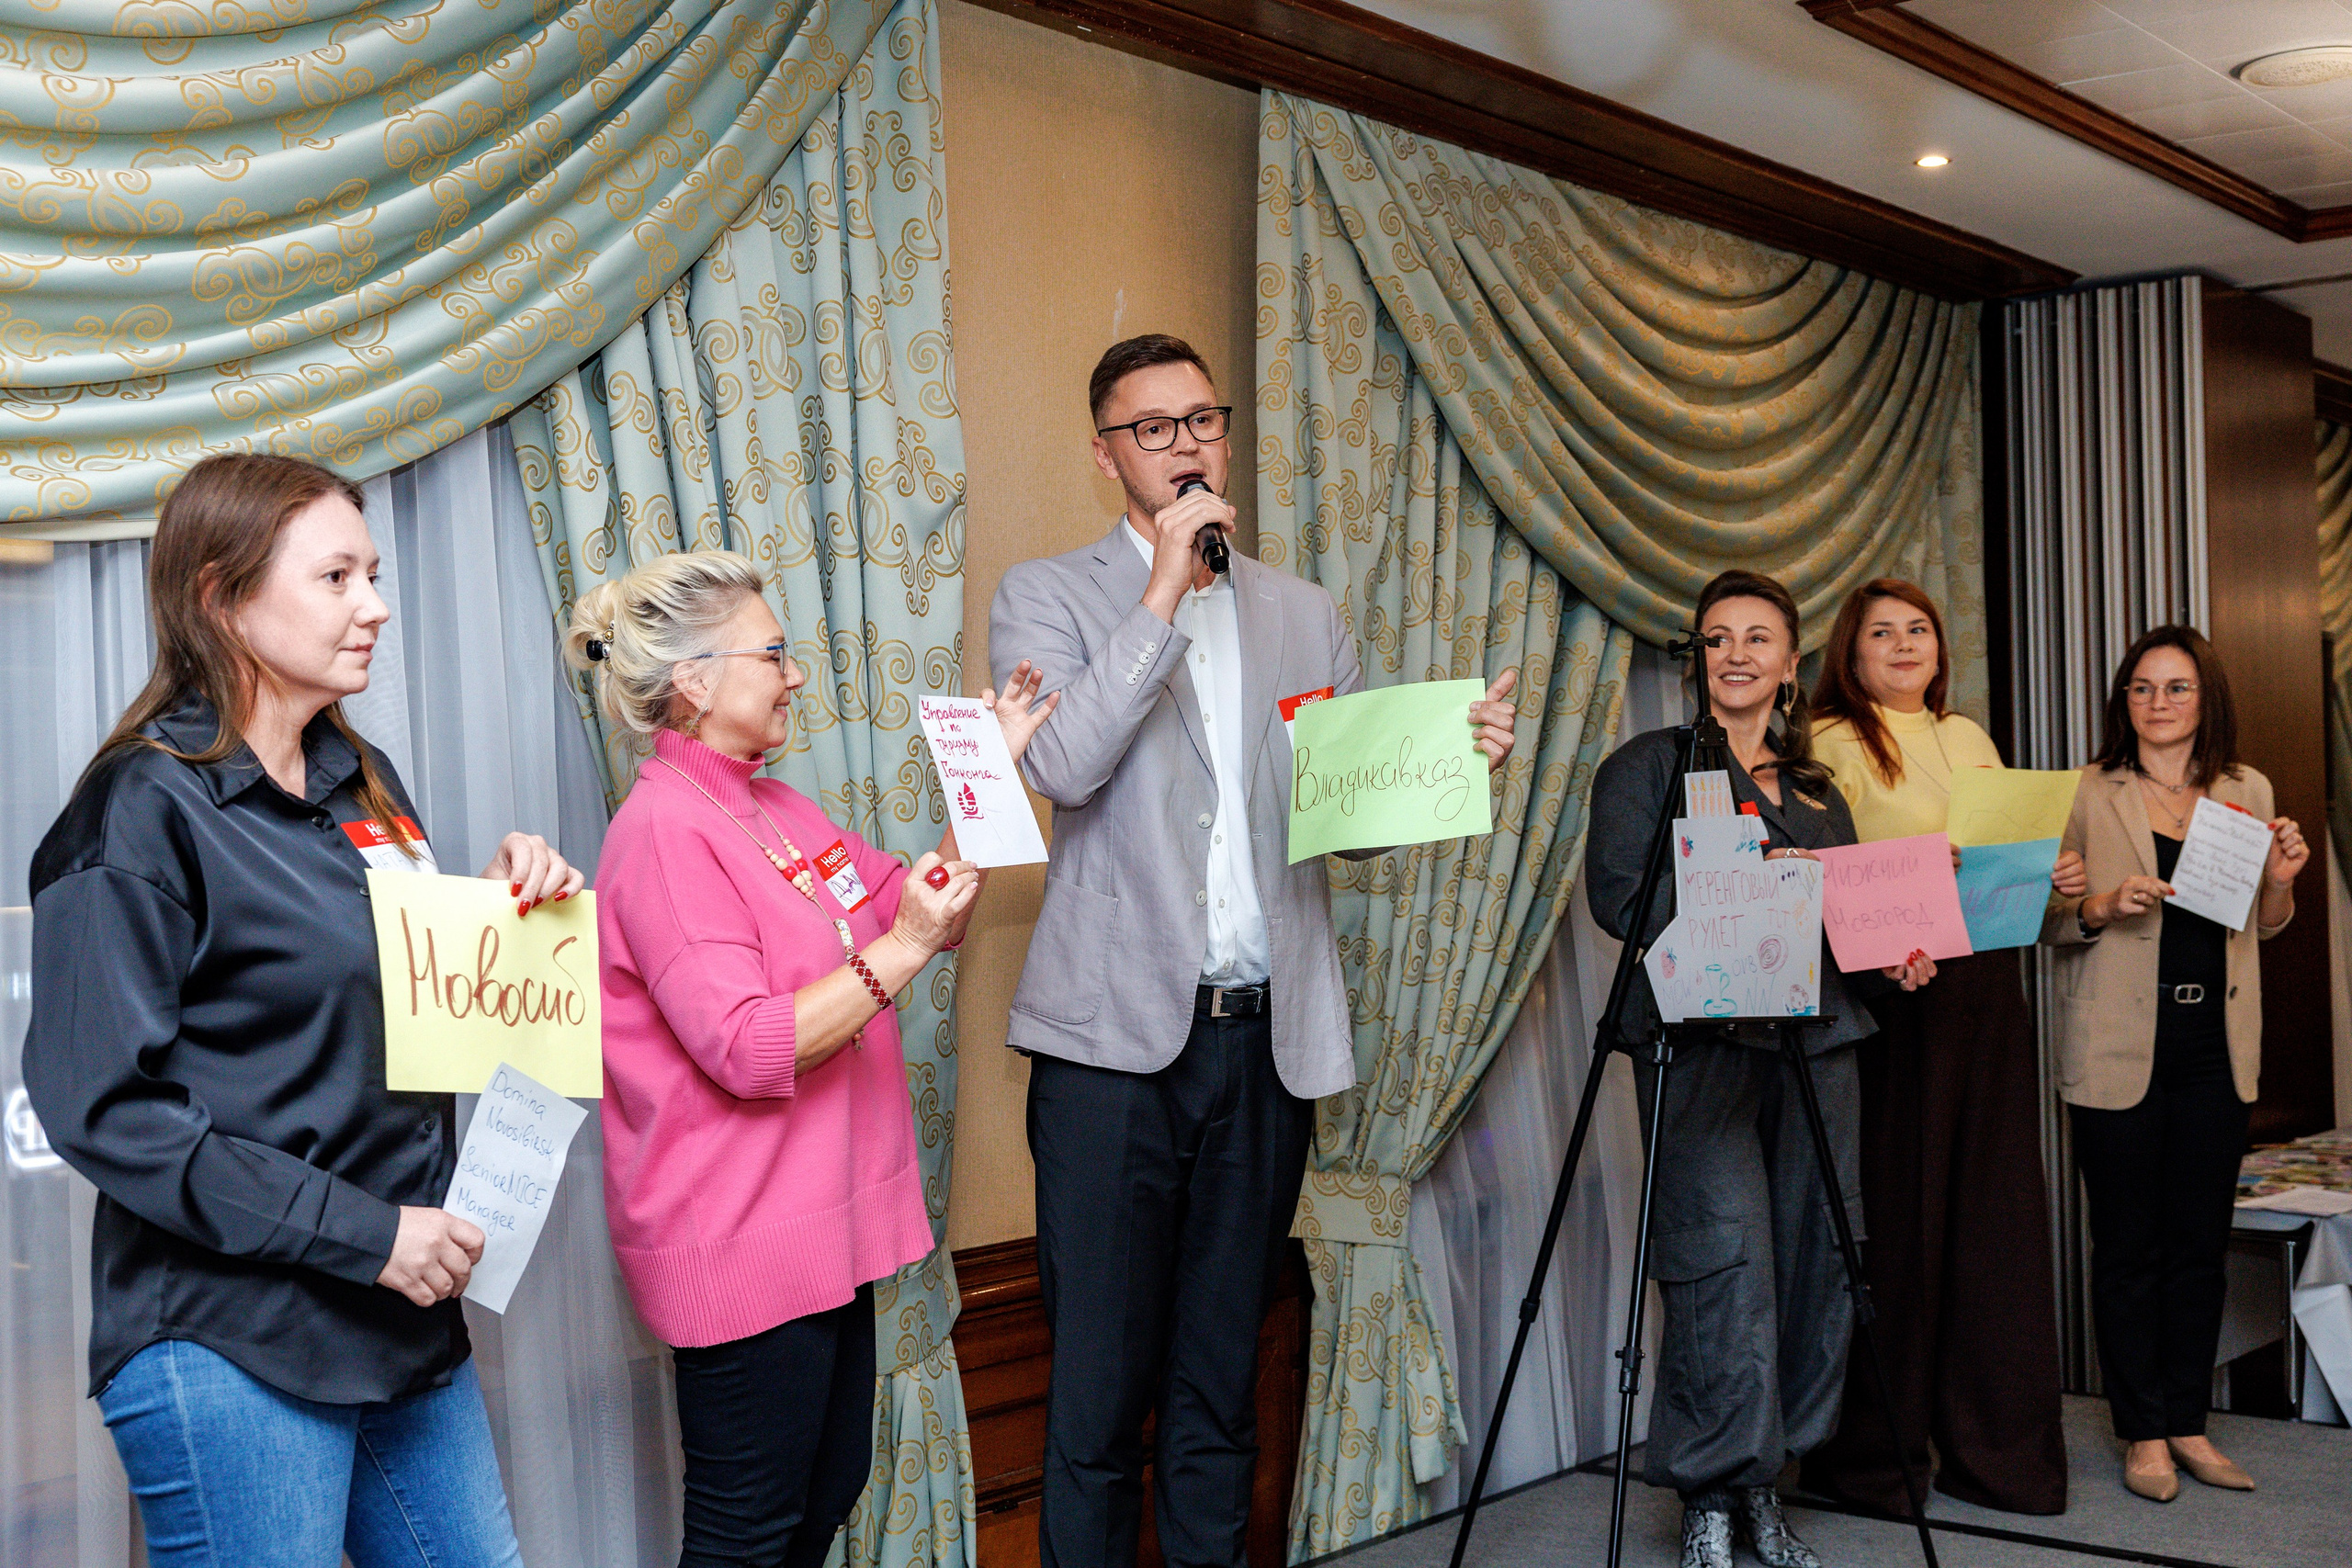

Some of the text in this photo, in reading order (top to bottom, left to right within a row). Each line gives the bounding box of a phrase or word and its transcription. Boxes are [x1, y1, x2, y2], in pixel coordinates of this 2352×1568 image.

[922, 700, 980, 733] Управление
[1299, 694, 1324, 707] Hello
[941, 760, 1002, 781] Гонконга
[1295, 736, 1470, 822] Владикавказ
[820, 846, 847, 868] Hello
[1683, 864, 1781, 908] МЕРЕНГОВЫЙ
[1688, 914, 1745, 951] РУЛЕТ
[400, 908, 585, 1027] Новосиб
[492, 1070, 546, 1122] Domina
